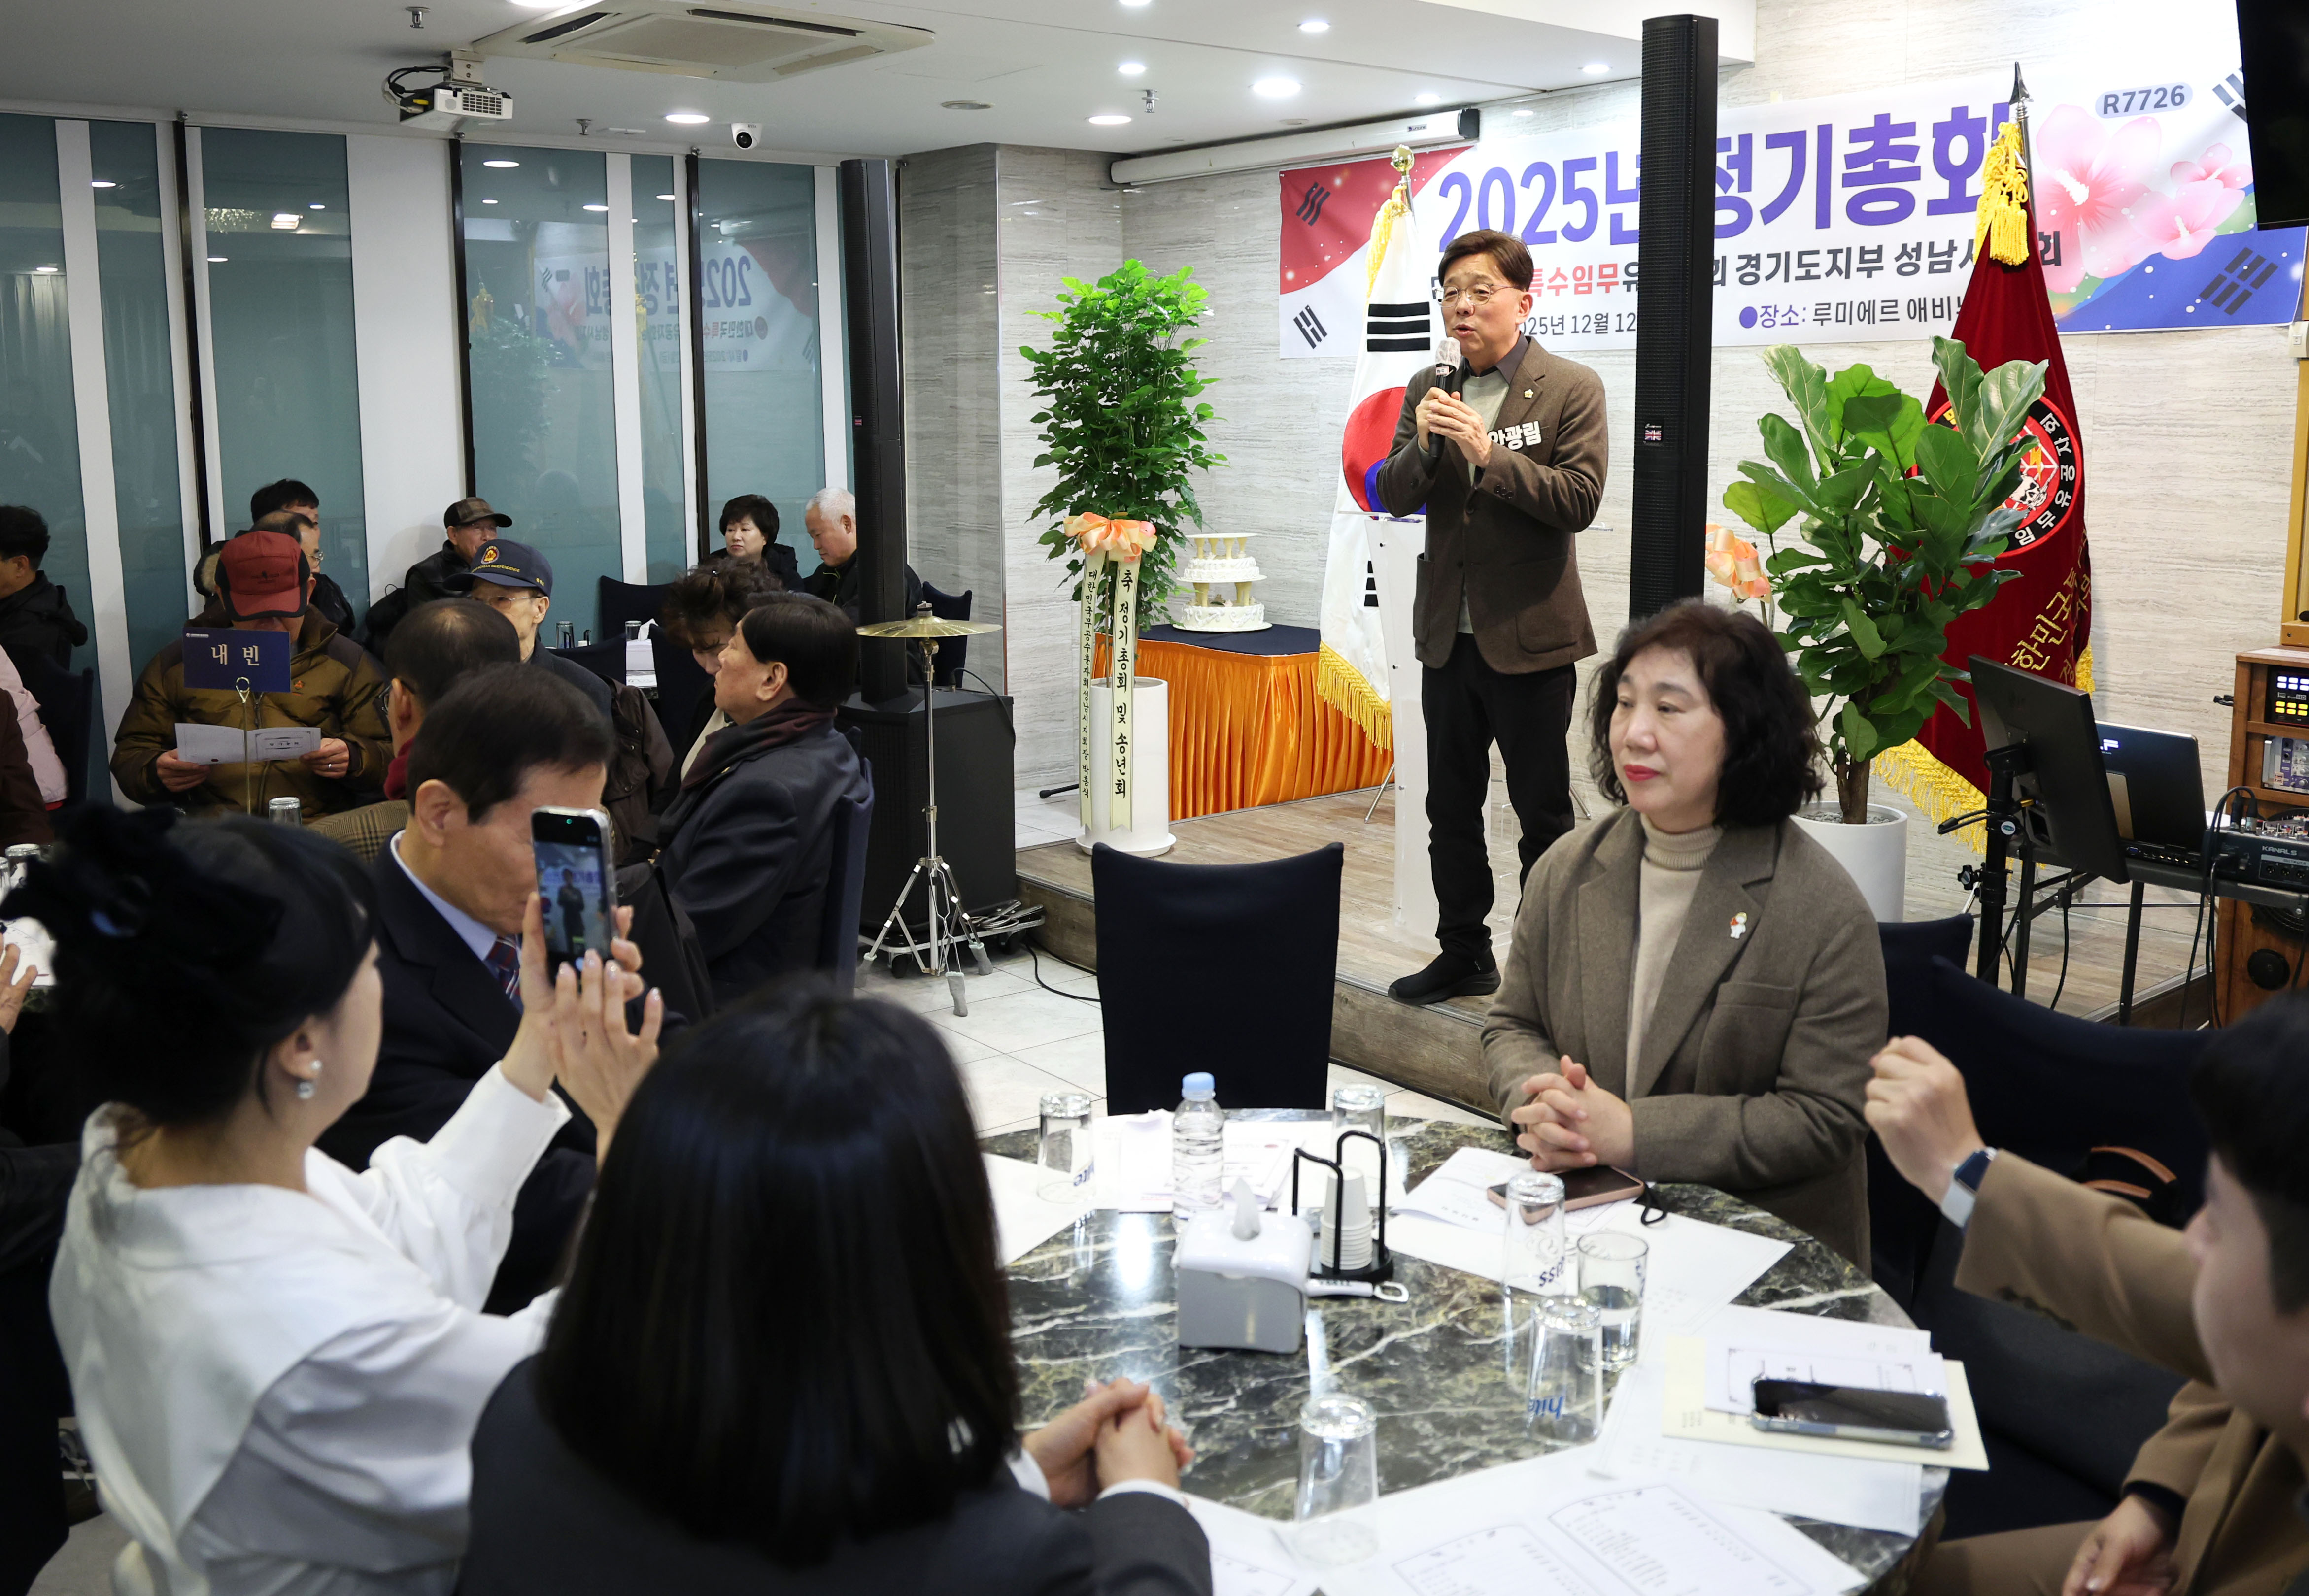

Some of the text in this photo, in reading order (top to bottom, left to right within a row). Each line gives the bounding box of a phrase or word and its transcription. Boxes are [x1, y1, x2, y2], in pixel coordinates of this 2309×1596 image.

[2103, 85, 2185, 114] R7726
[1736, 245, 1883, 286] 경기도지부
[1571, 313, 1609, 334] 12월
[1760, 304, 1806, 328] 장소:
[1813, 299, 1900, 326] 루미에르
[1907, 296, 1962, 322] 애비
[1115, 569, 1133, 799] 축 정기총회 및 송년회
[2262, 845, 2297, 856] KANALS
